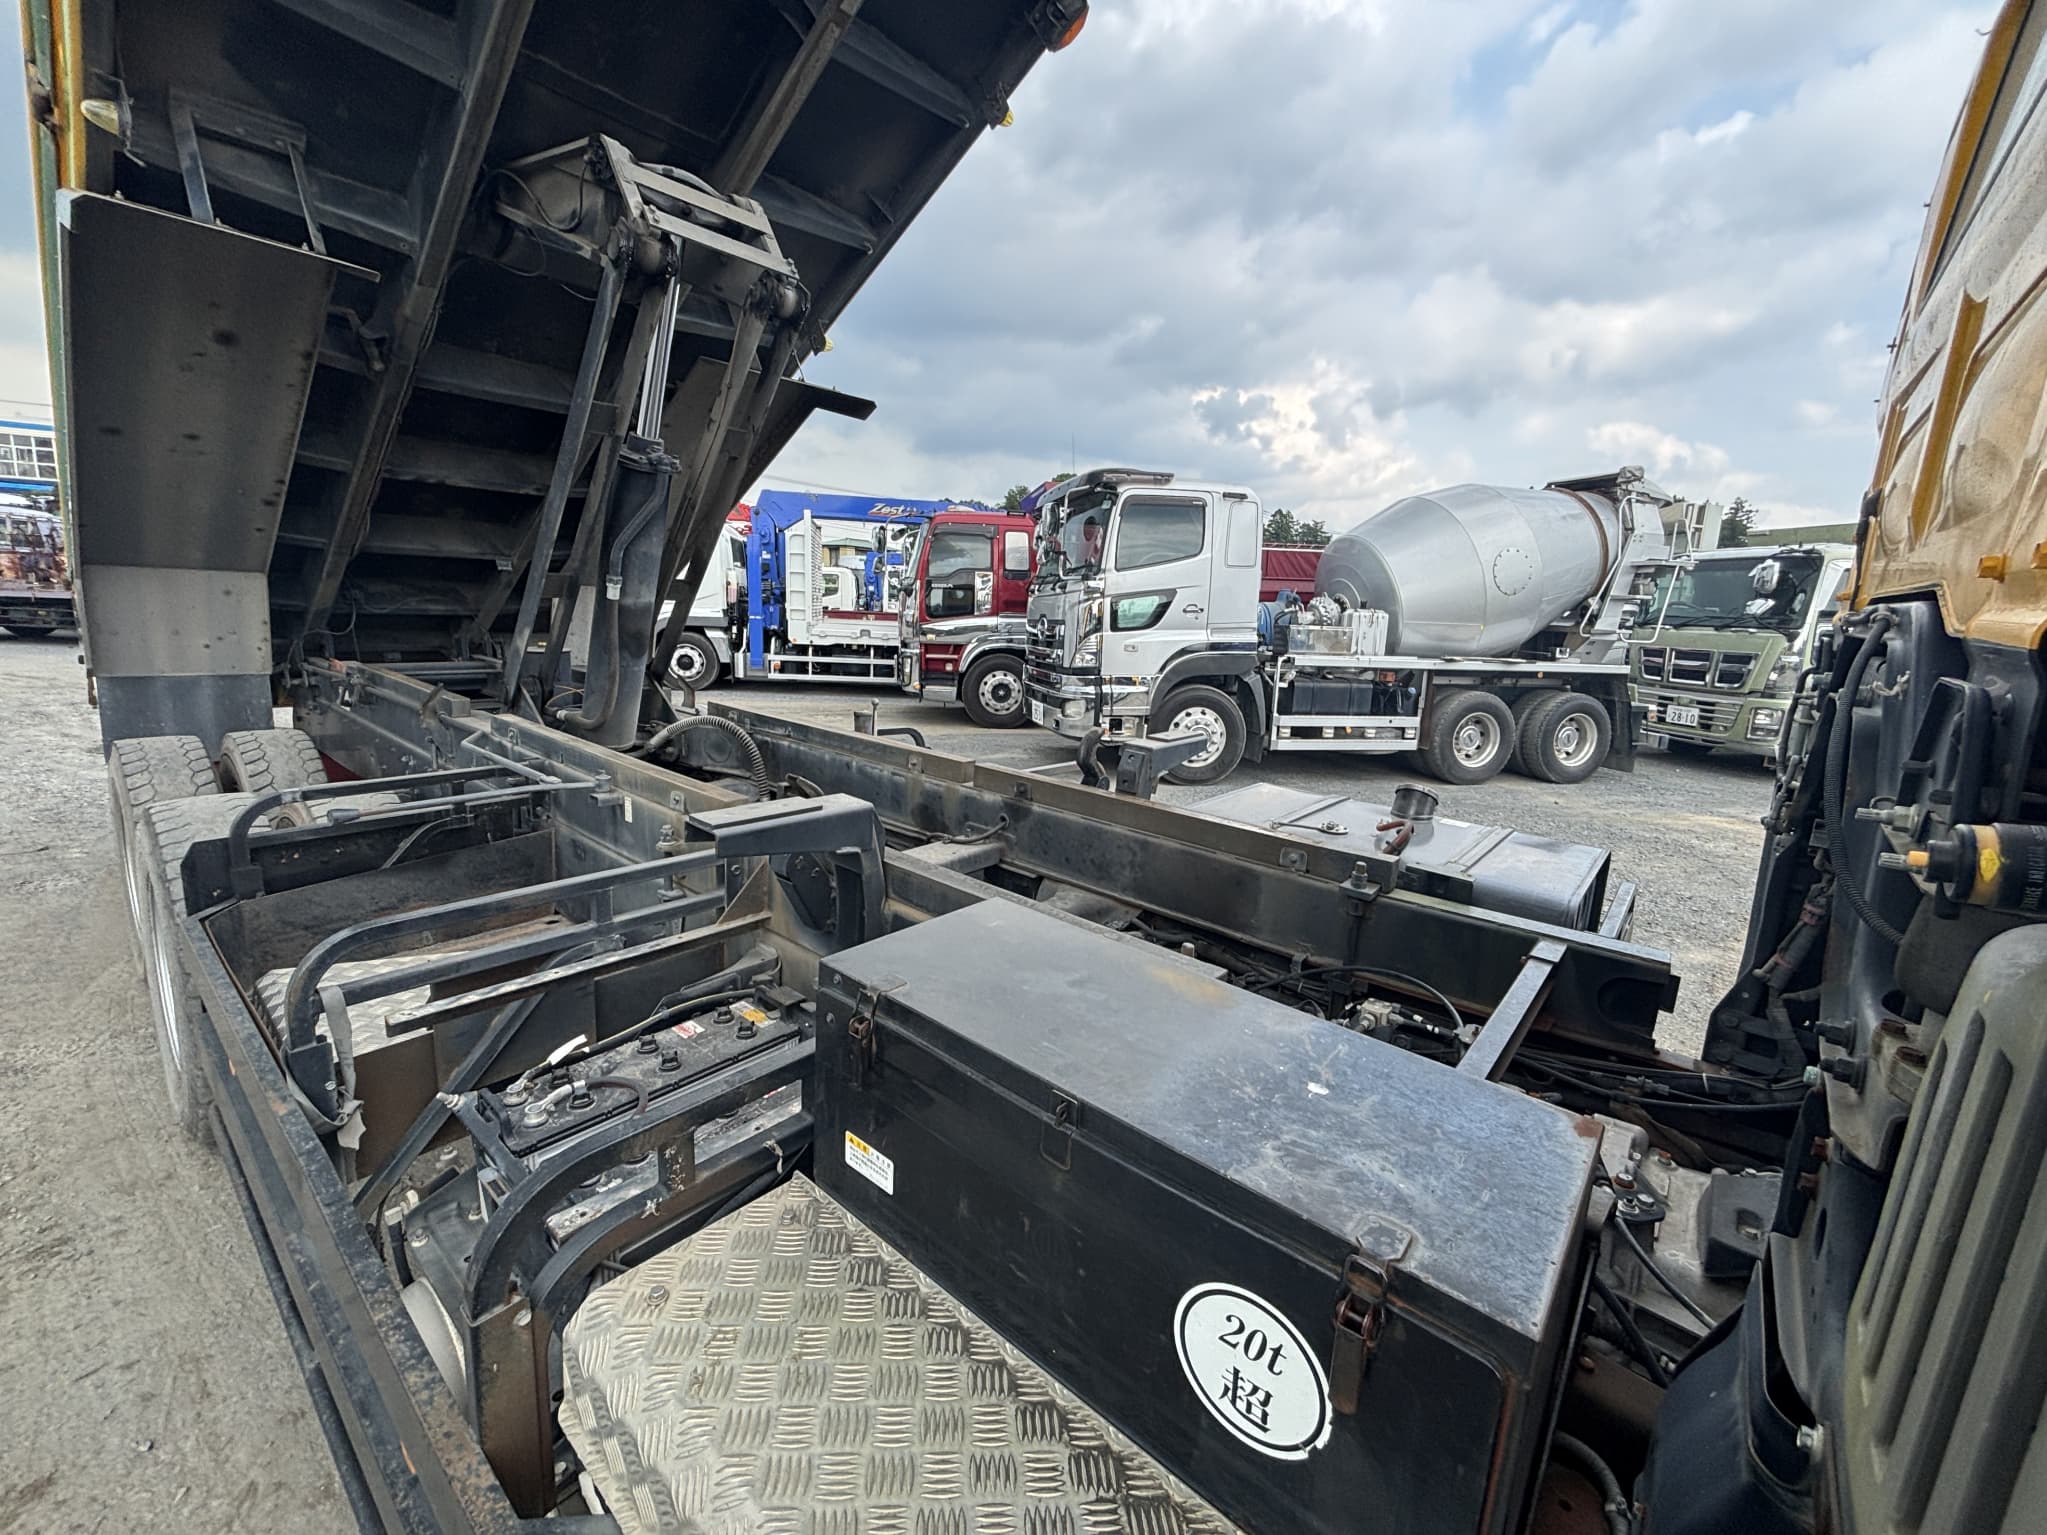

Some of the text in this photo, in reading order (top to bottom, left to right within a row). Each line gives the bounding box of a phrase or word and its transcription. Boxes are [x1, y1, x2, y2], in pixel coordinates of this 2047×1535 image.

[868, 503, 905, 515] Zest
[1218, 1314, 1287, 1376] 20t
[1218, 1365, 1274, 1433] 超
